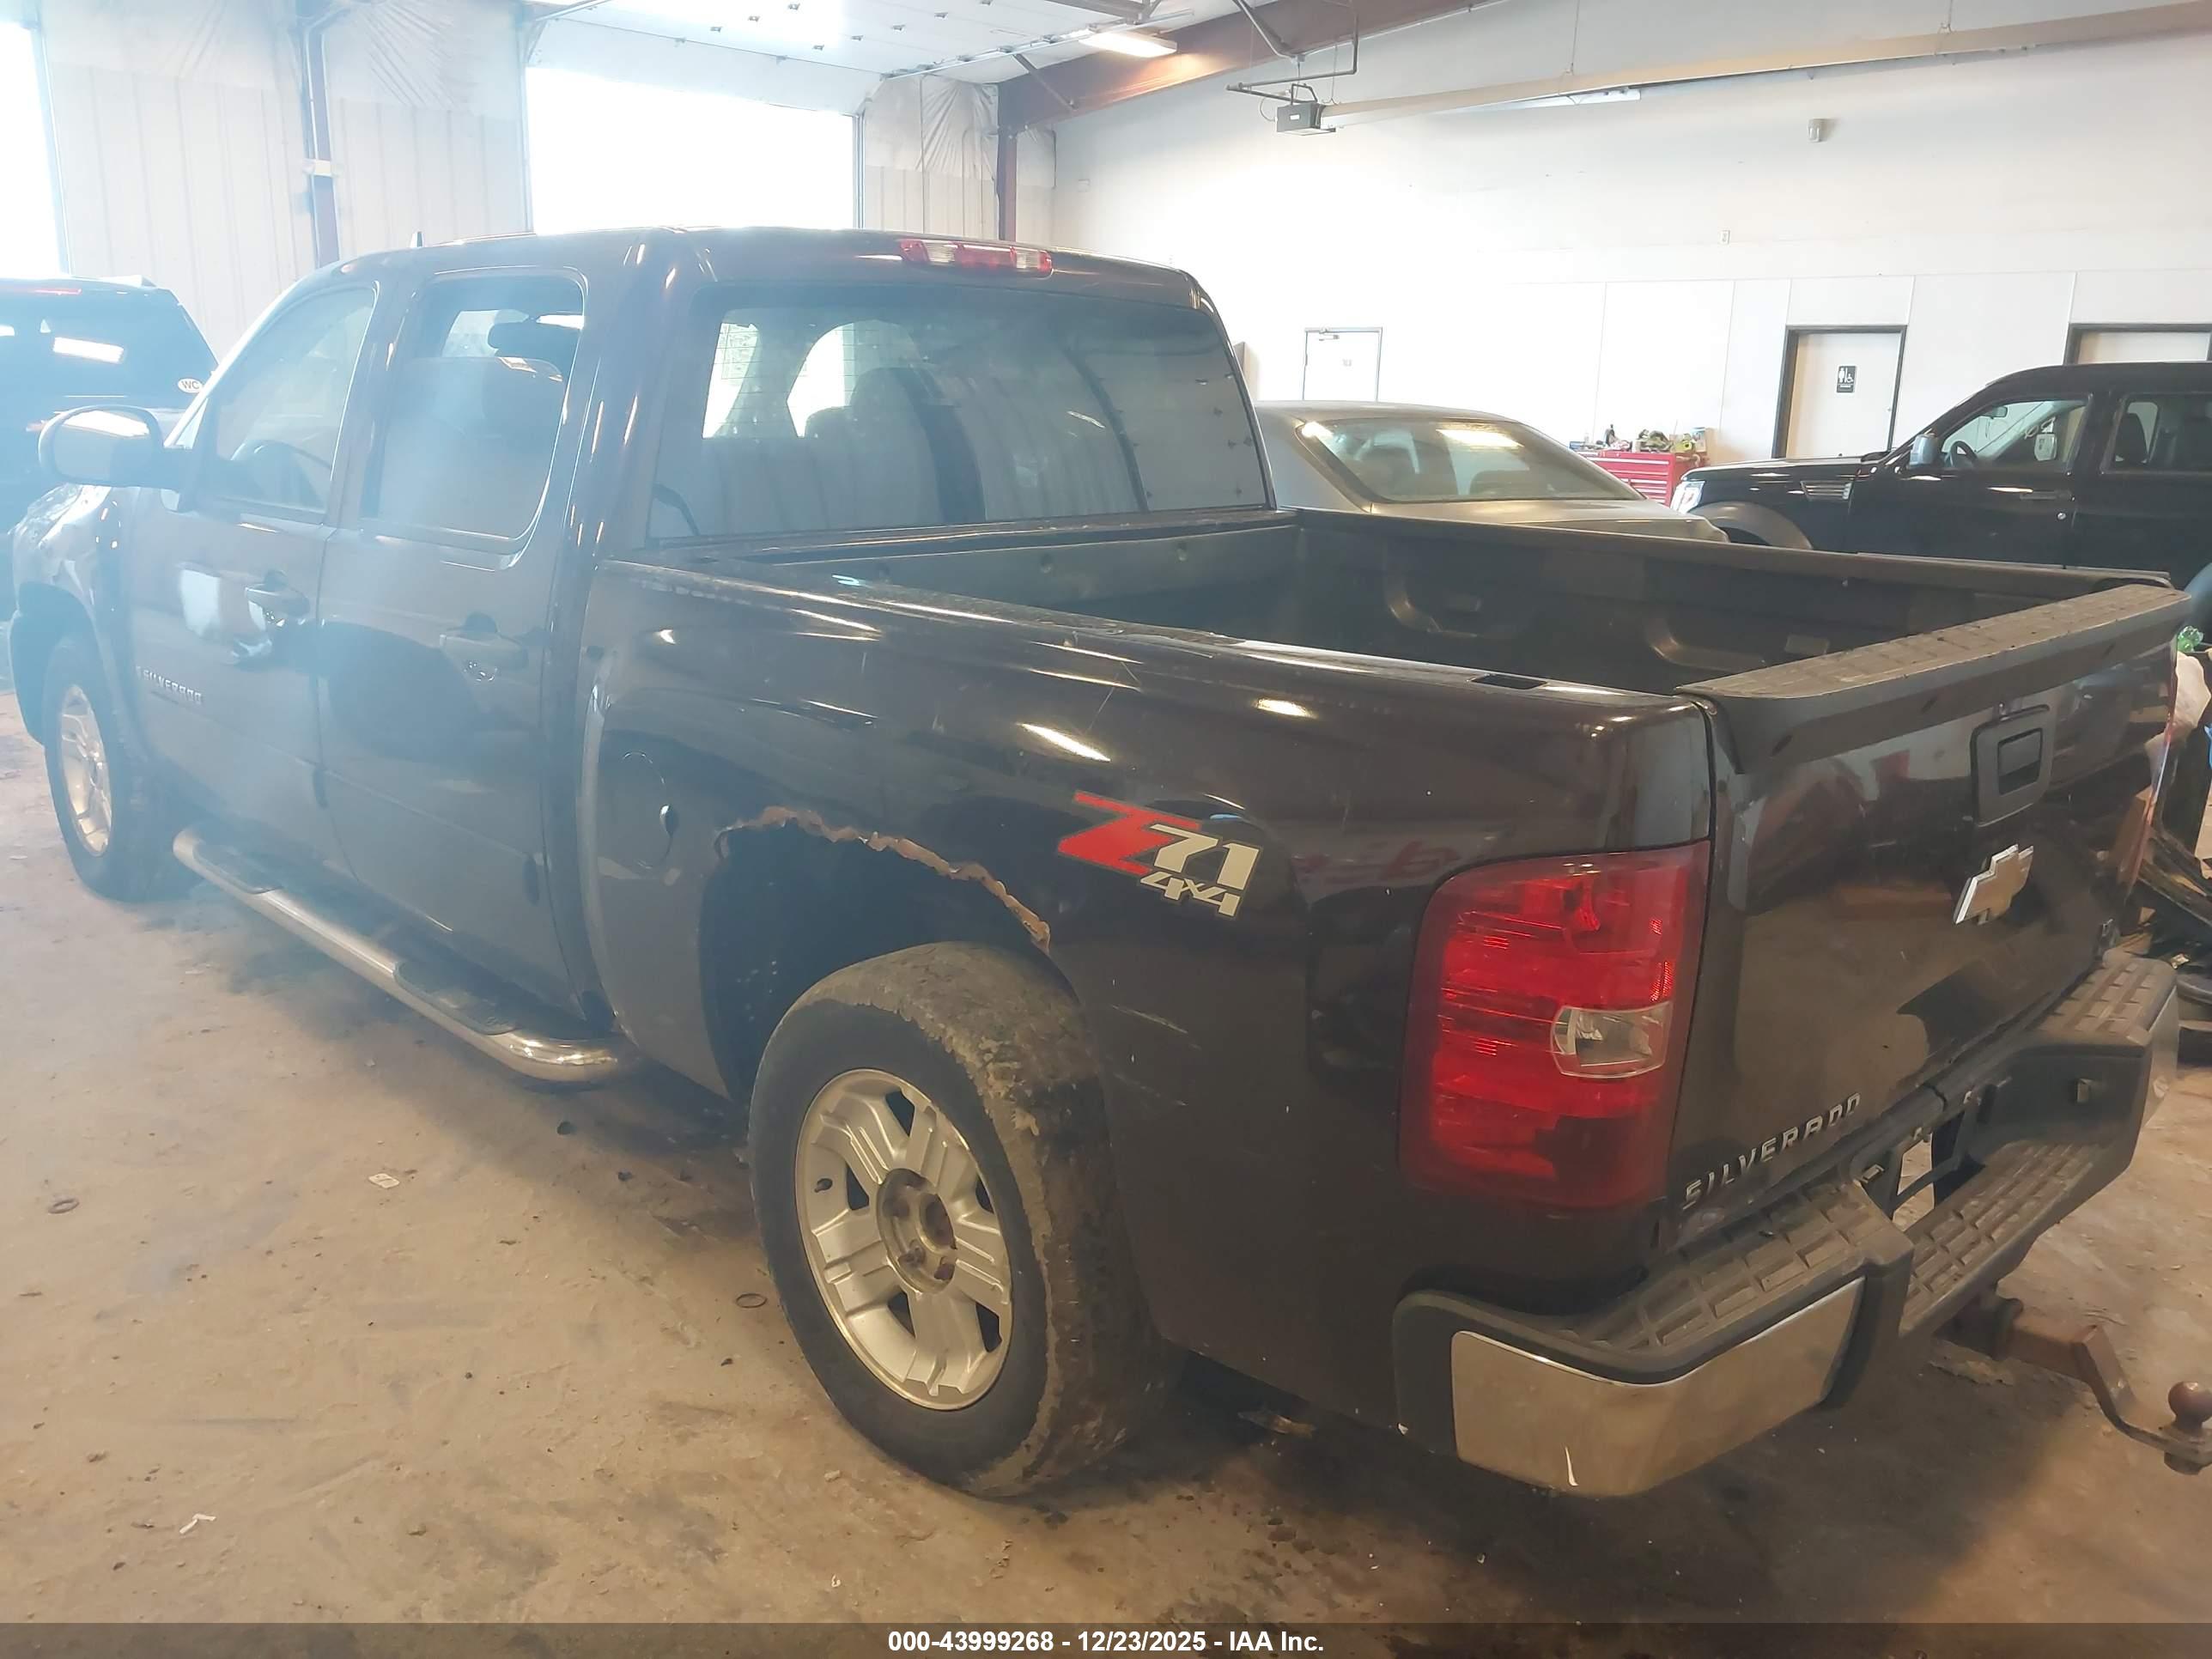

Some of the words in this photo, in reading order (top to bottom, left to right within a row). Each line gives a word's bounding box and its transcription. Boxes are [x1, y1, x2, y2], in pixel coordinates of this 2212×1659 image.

[181, 380, 200, 390] WC
[1058, 789, 1260, 890] Z71
[1682, 1092, 1861, 1210] SILVERADO
